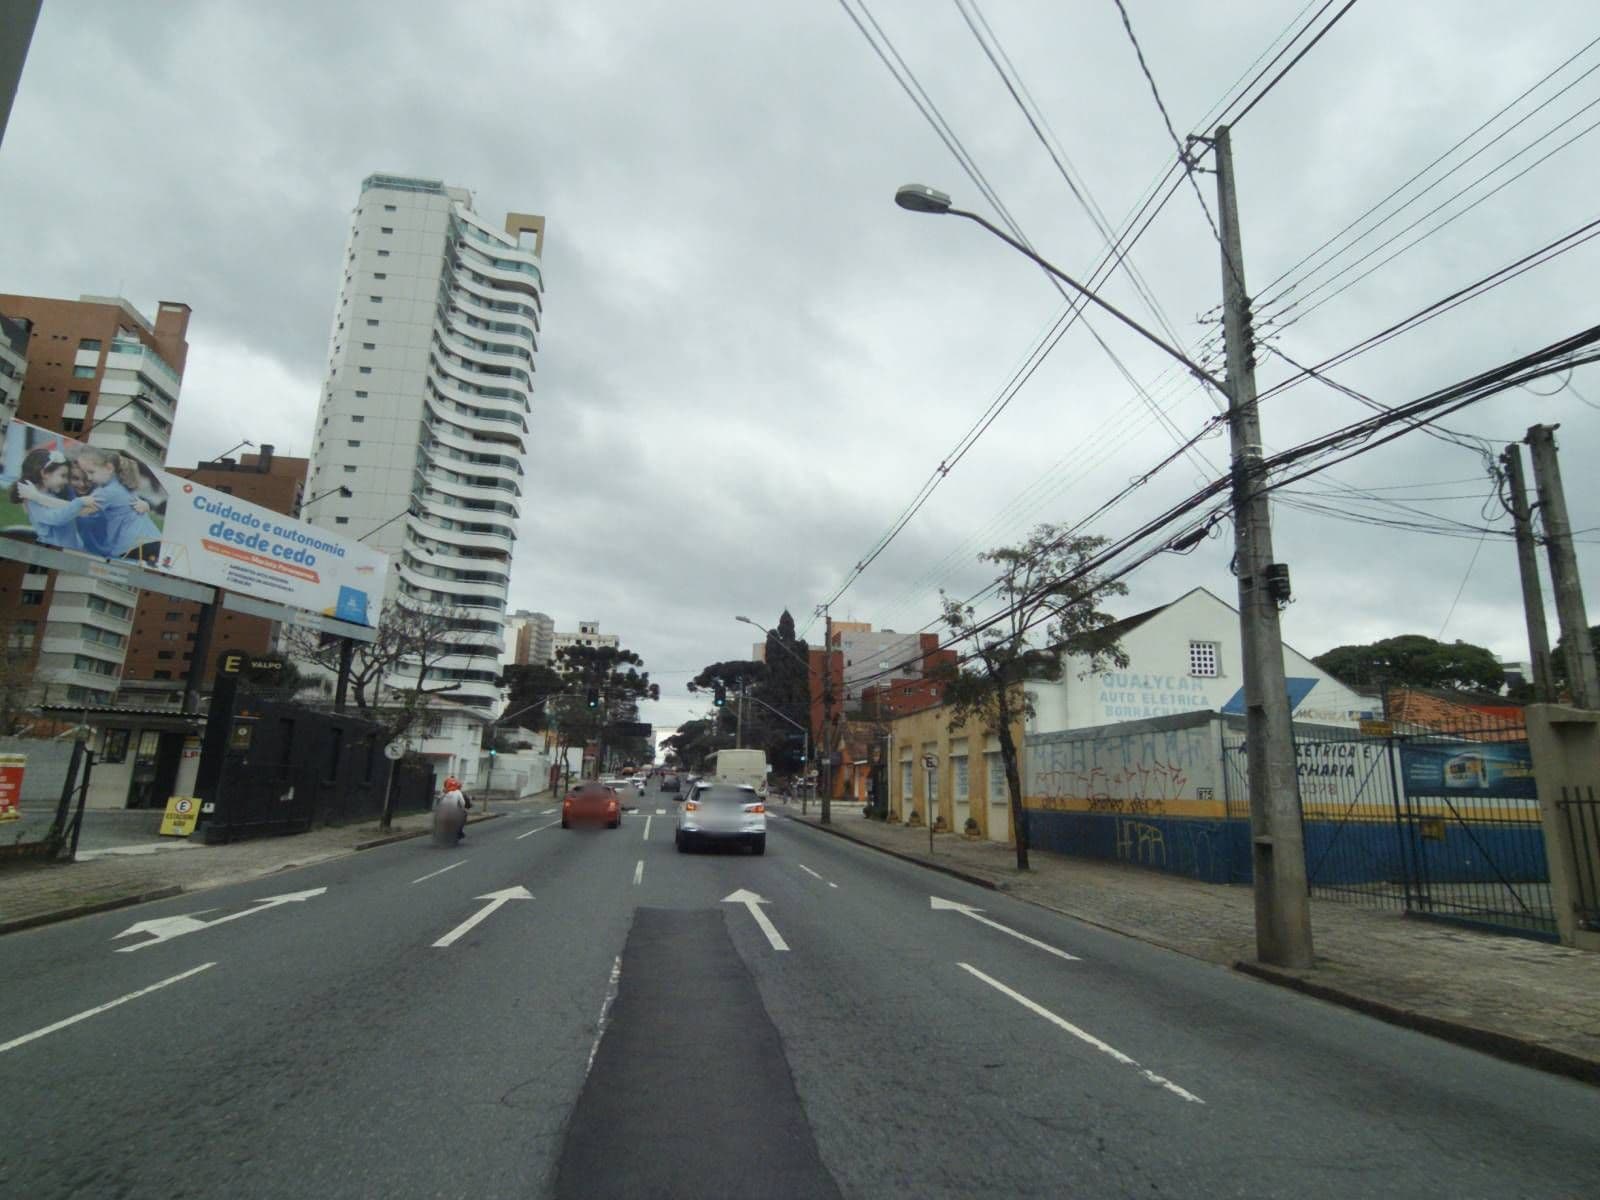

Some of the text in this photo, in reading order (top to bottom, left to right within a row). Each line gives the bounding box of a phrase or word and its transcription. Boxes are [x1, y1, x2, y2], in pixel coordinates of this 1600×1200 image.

[193, 495, 260, 528] Cuidado
[262, 521, 271, 532] e
[273, 525, 346, 558] autonomia
[209, 521, 270, 552] desde
[271, 543, 316, 567] cedo
[224, 655, 241, 672] E
[1103, 672, 1204, 691] QUALYCAR
[1100, 691, 1136, 703] AUTO
[1296, 741, 1356, 758] LETRICA
